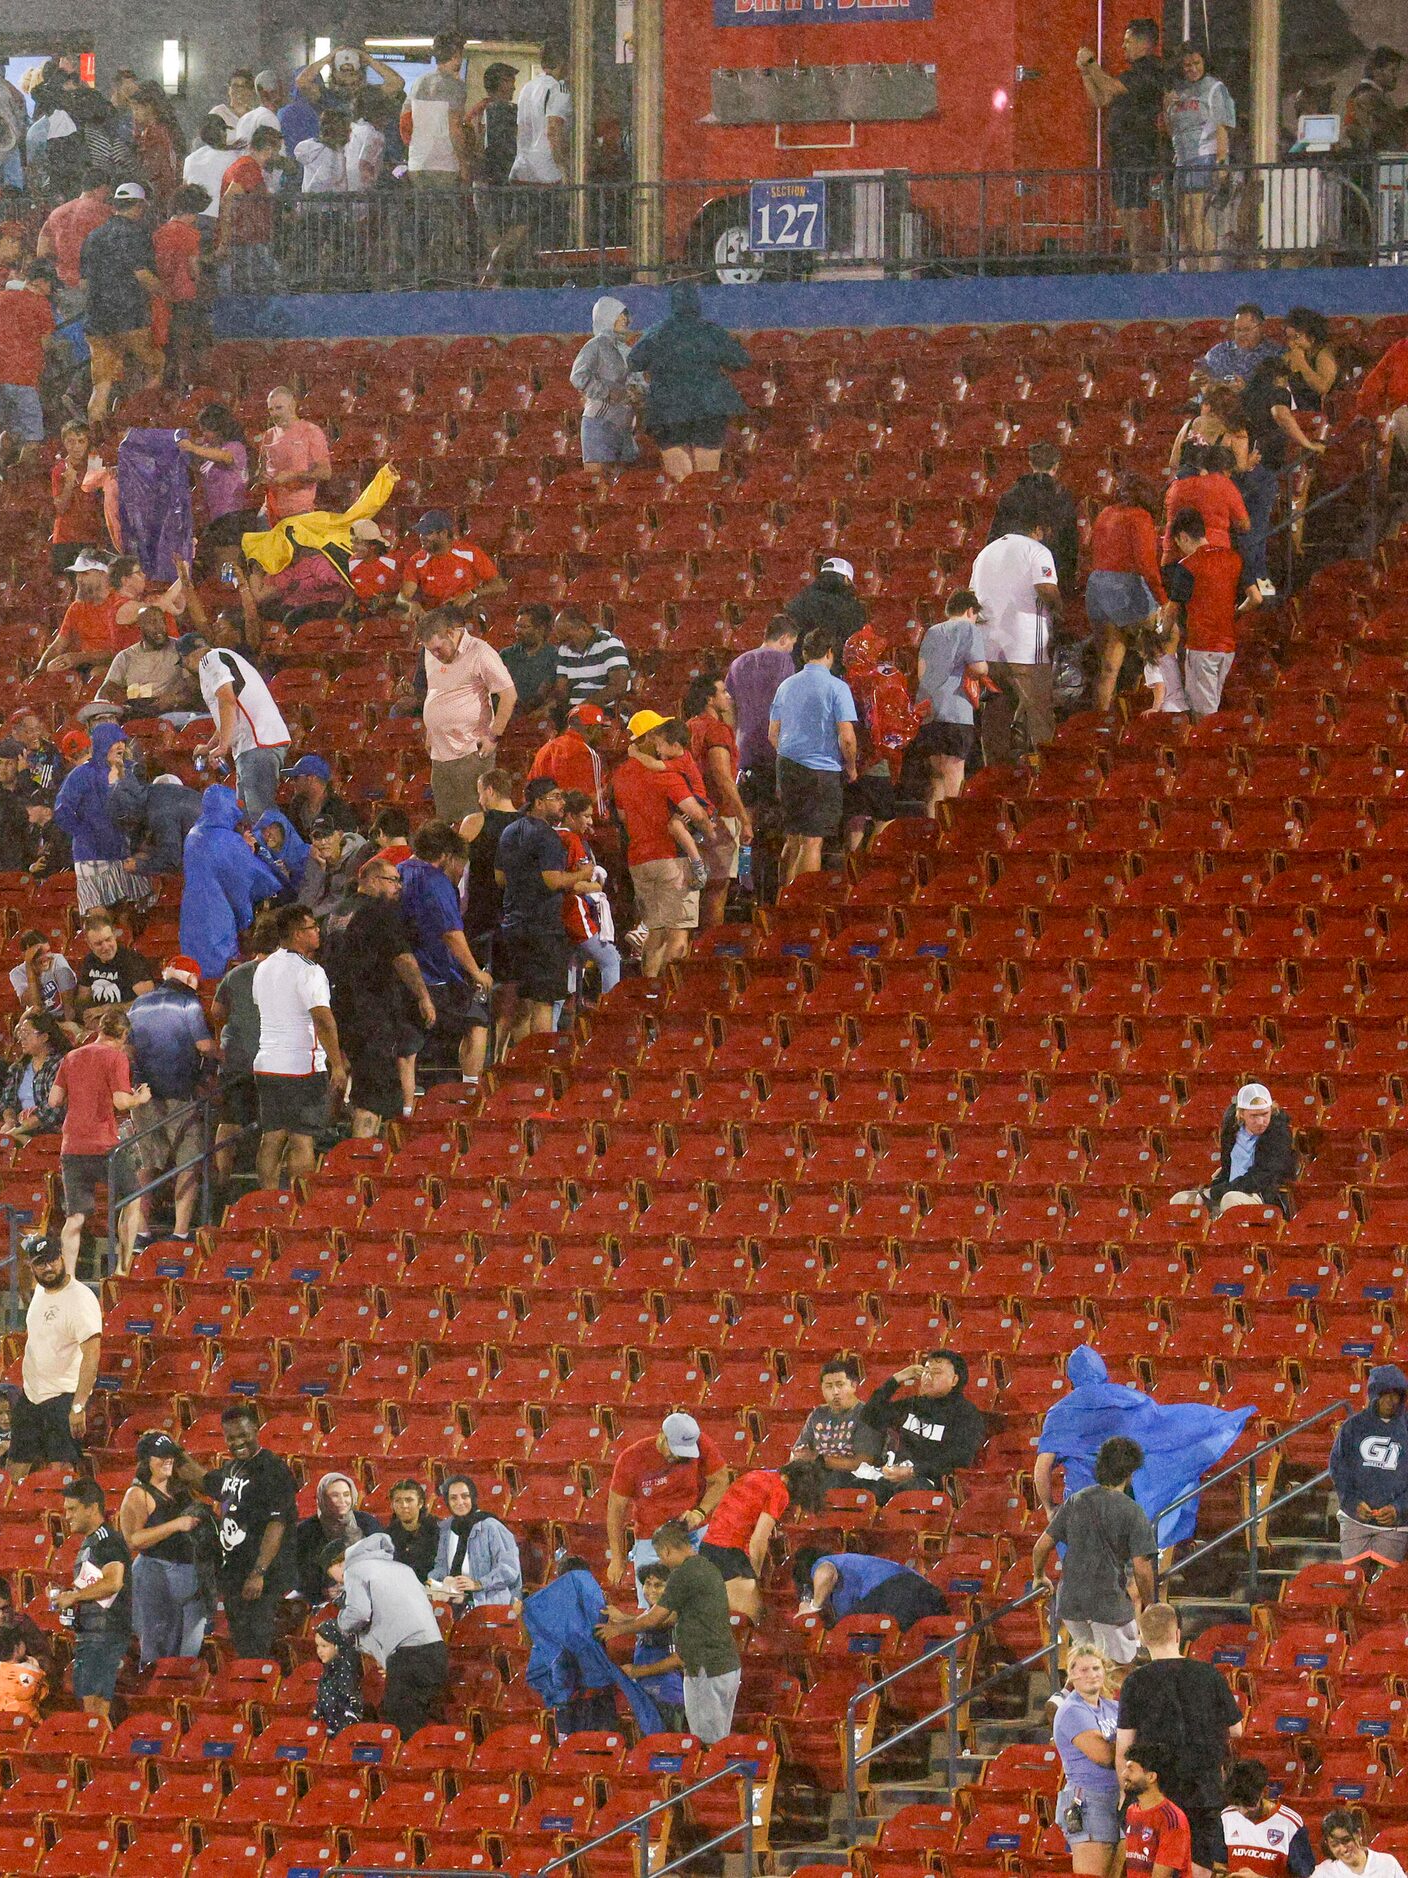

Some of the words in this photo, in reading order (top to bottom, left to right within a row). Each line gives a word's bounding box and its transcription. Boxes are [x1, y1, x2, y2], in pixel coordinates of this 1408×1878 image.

[770, 186, 806, 199] SECTION
[757, 204, 818, 247] 127
[1232, 1848, 1278, 1861] ADVOCARE
